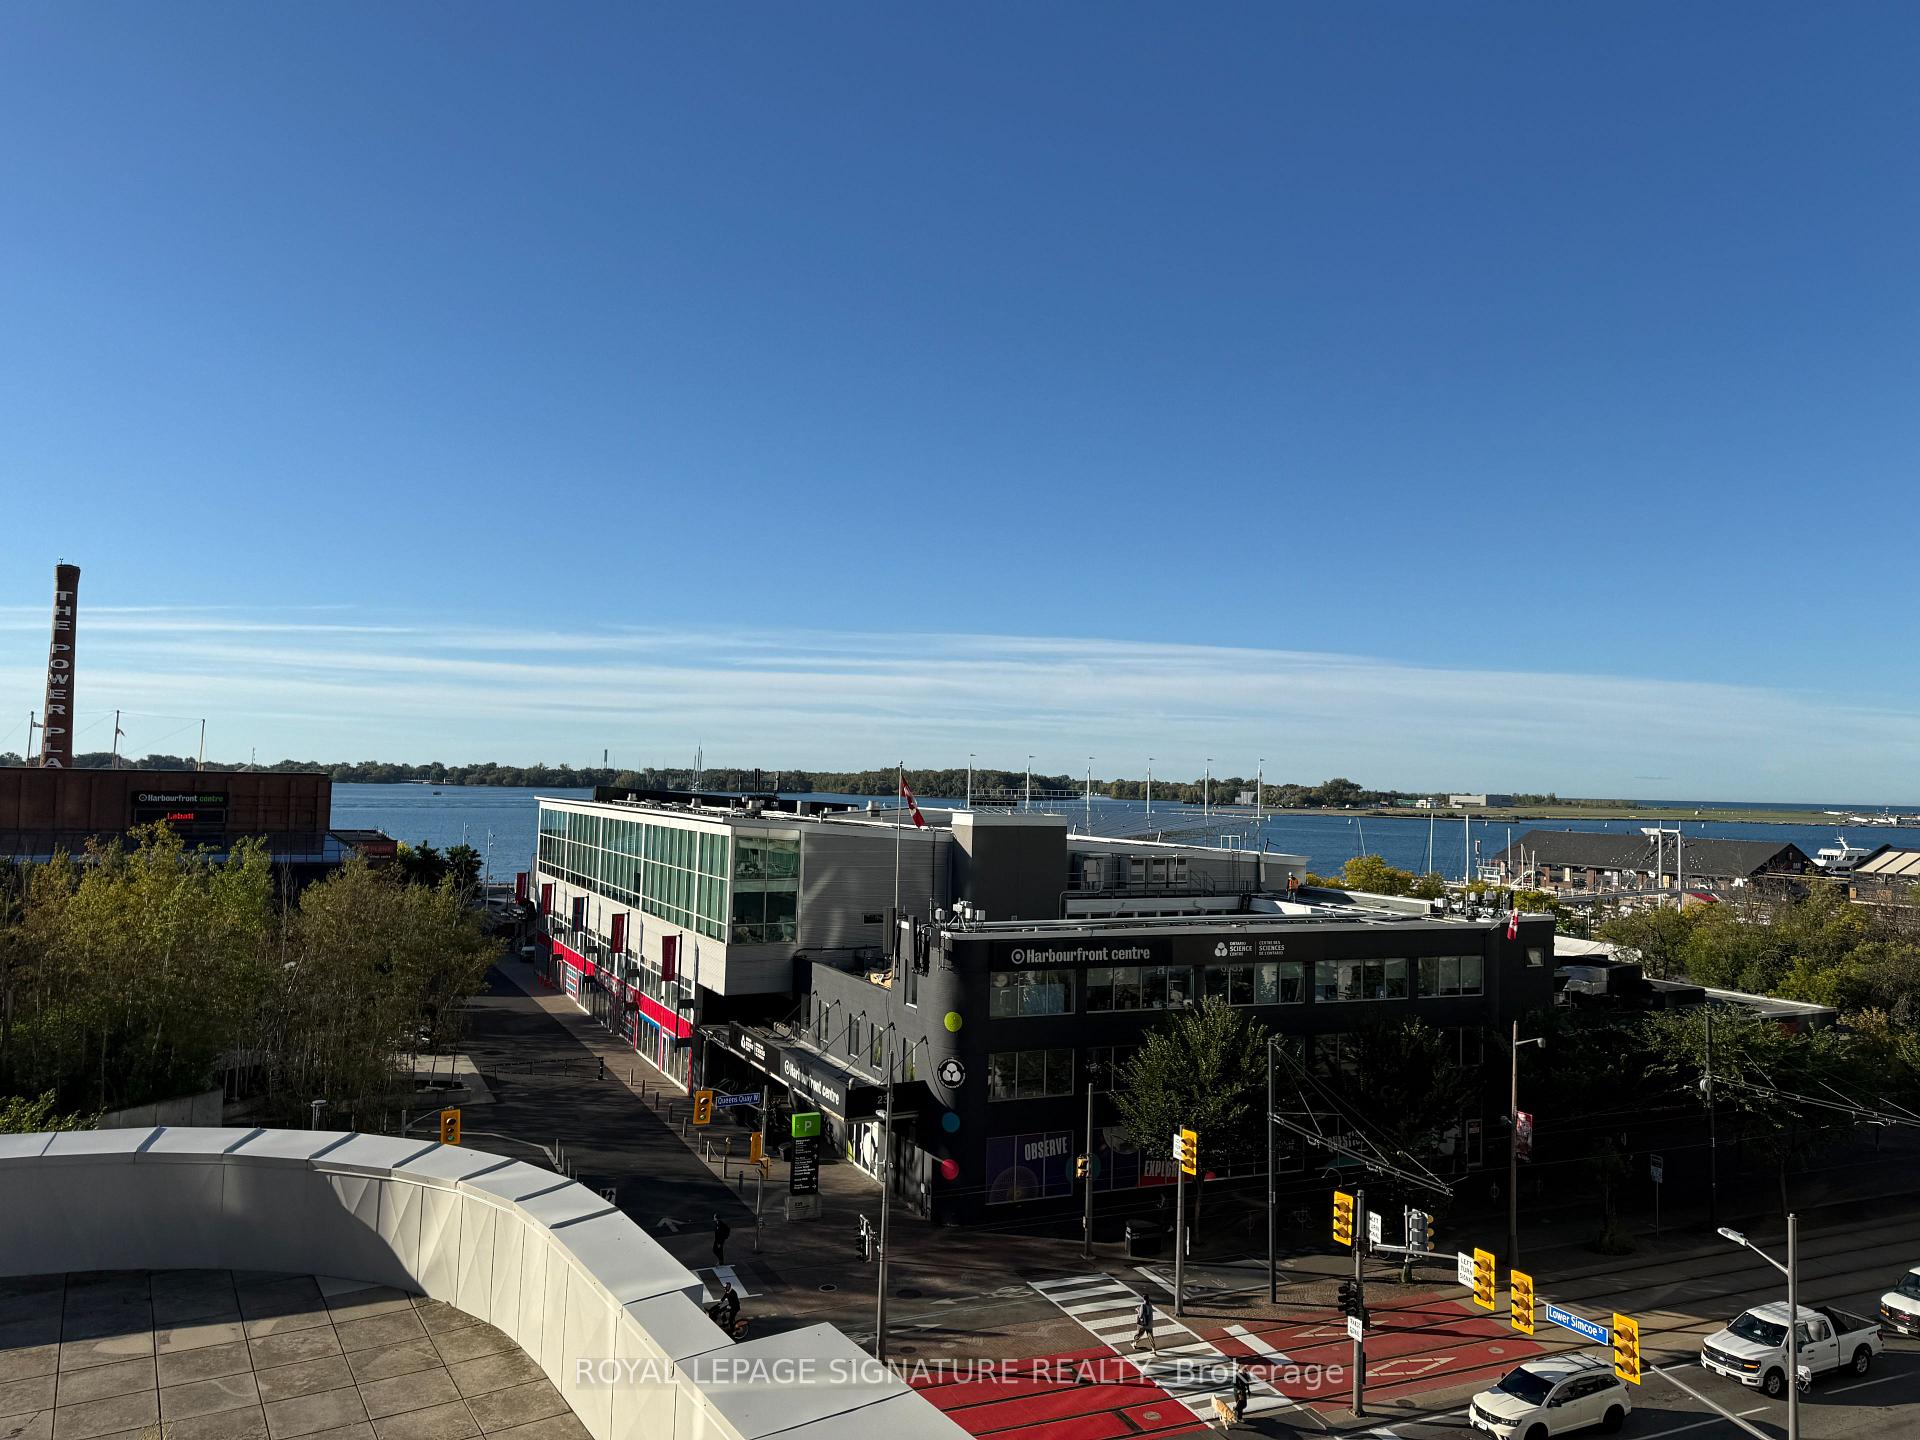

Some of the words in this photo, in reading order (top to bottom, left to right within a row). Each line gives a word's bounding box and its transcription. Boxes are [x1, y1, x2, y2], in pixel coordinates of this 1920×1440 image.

[54, 590, 73, 631] THE
[48, 643, 71, 715] POWER
[147, 794, 198, 802] Harbourfront
[1258, 944, 1285, 952] SCIENCES
[1026, 947, 1109, 964] Harbourfront
[1111, 946, 1151, 960] centre
[717, 1097, 738, 1105] Queens
[738, 1095, 753, 1104] Quay
[822, 1084, 840, 1106] centre
[804, 1120, 812, 1132] P
[1023, 1136, 1068, 1162] OBSERVE
[1460, 1257, 1472, 1268] LEFT
[1460, 1265, 1473, 1276] TURN
[1459, 1272, 1474, 1285] SIGNAL
[1549, 1306, 1570, 1325] Lower
[1570, 1316, 1598, 1336] Simcoe
